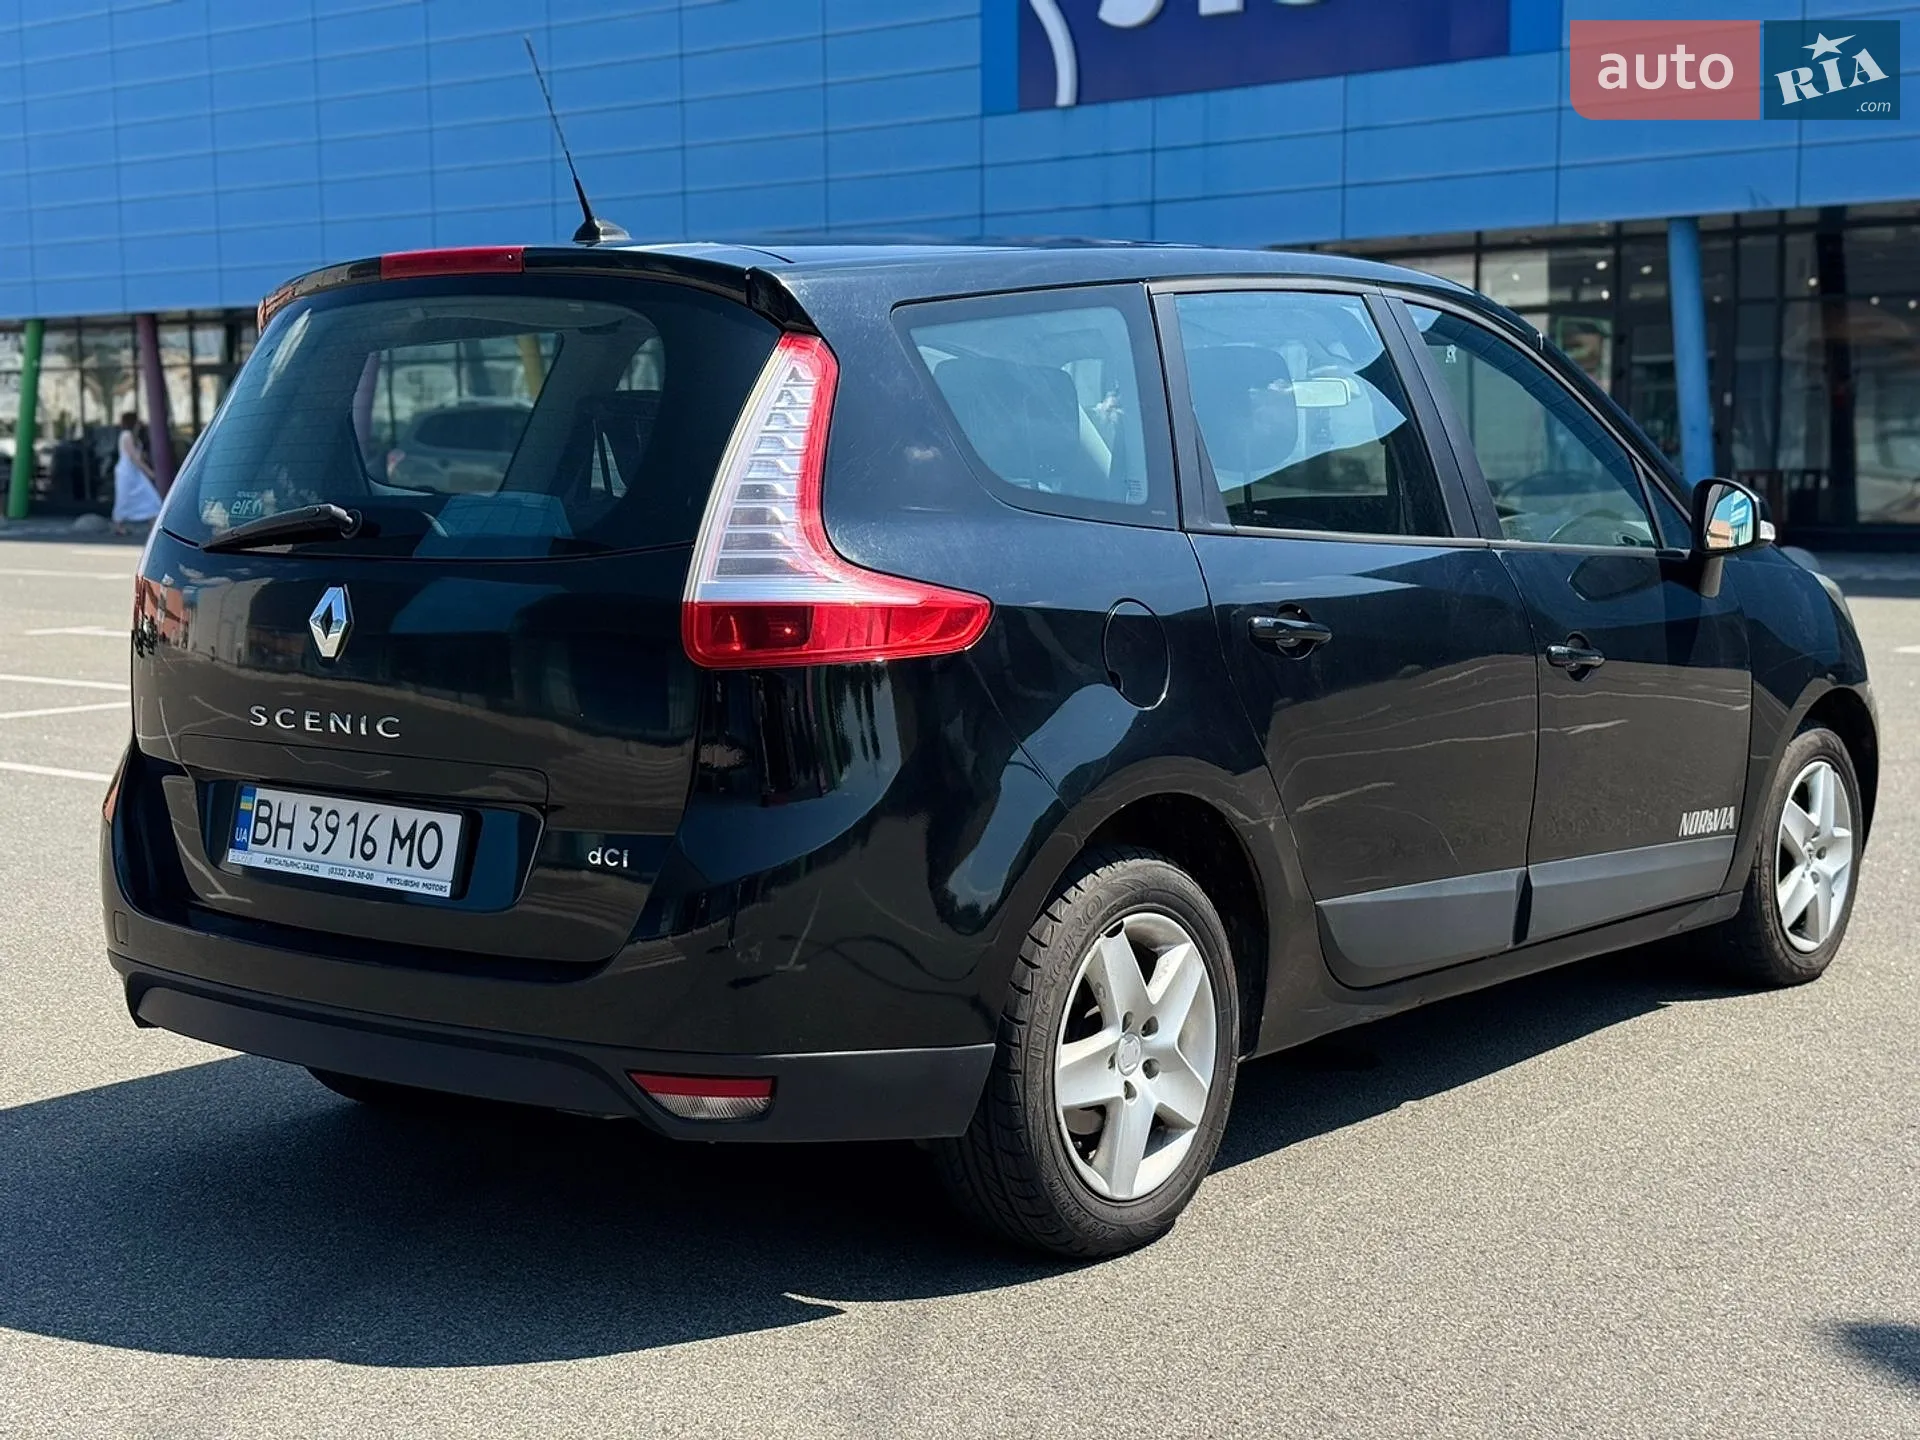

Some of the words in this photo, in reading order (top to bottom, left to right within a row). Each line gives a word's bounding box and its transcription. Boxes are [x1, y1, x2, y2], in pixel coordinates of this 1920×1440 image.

[249, 704, 401, 739] SCENIC
[234, 826, 248, 843] UA
[251, 799, 297, 851] BH
[302, 806, 382, 862] 3916
[387, 817, 443, 870] MO
[587, 846, 629, 868] dCi
[385, 876, 420, 888] MITSUBISHI
[421, 882, 448, 893] MOTORS
